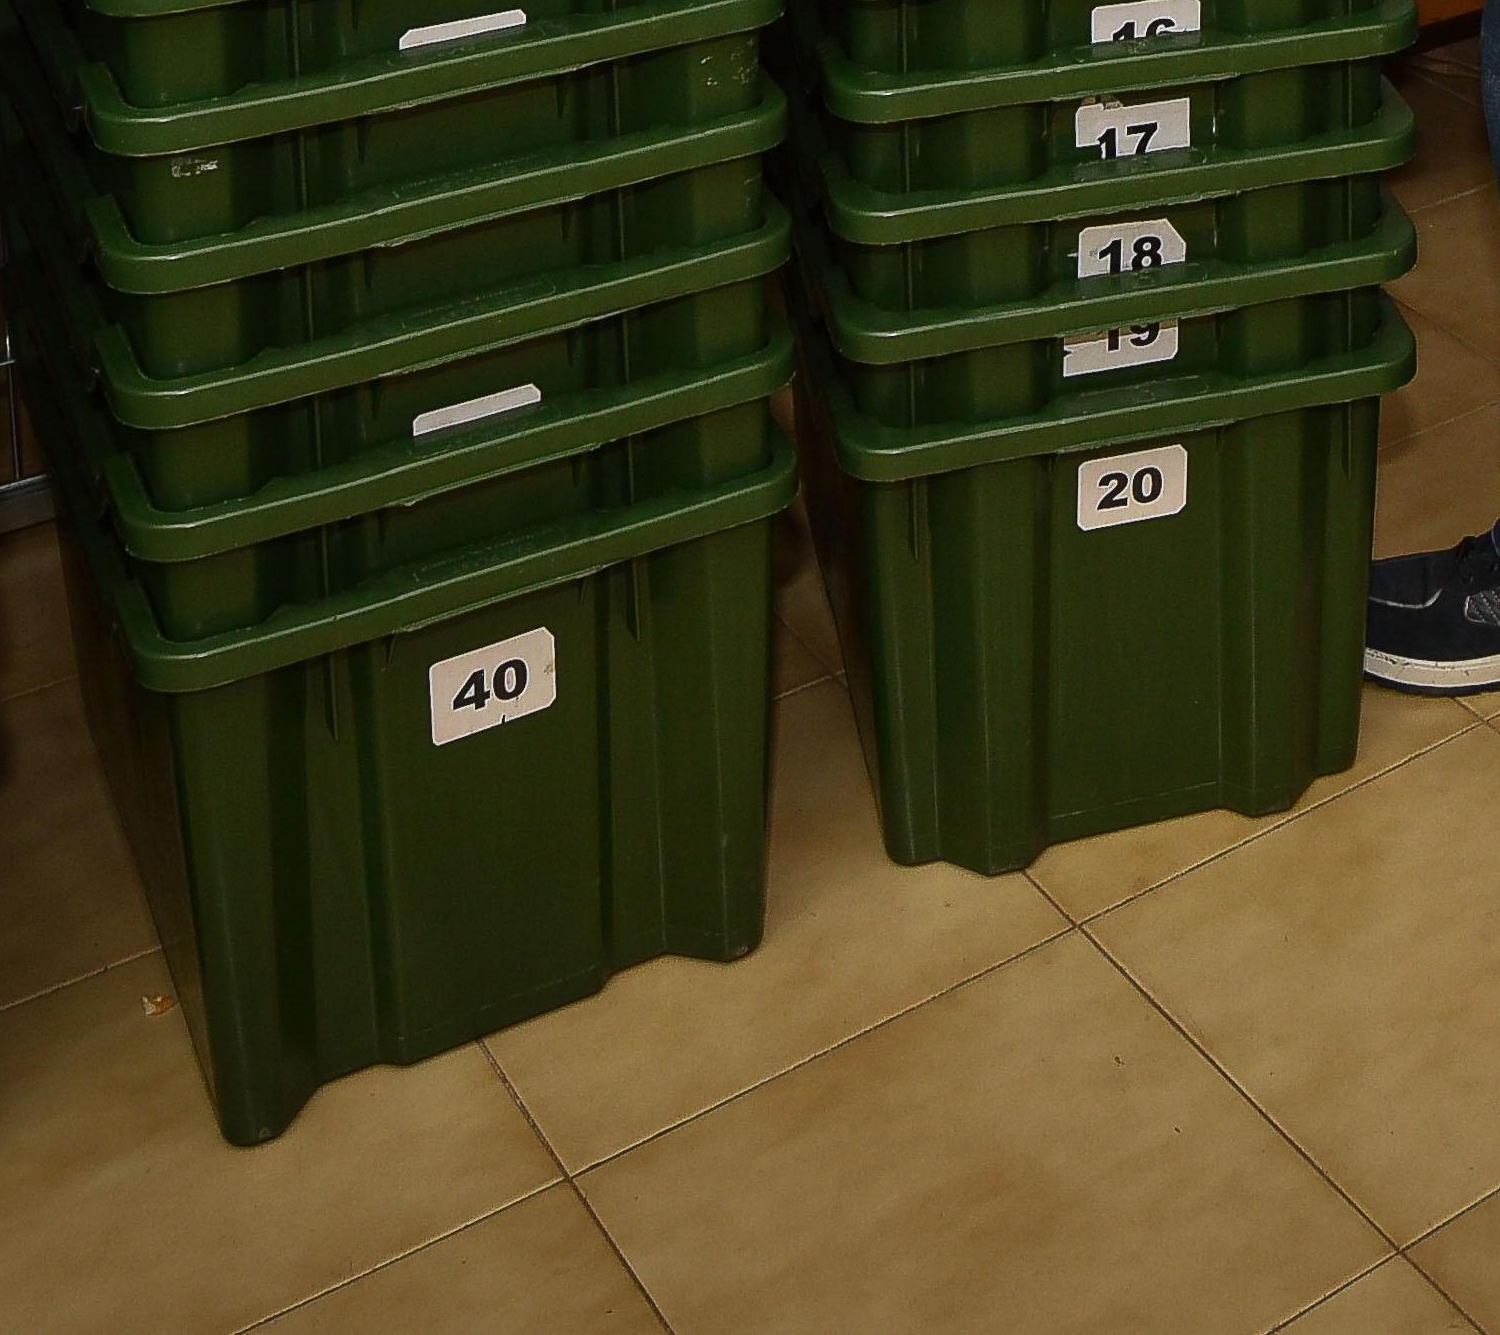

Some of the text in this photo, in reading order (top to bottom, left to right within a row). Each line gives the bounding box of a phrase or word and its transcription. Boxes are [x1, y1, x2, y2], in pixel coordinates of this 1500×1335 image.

[1096, 121, 1159, 160] 17
[1097, 236, 1163, 273] 18
[1096, 466, 1164, 511] 20
[451, 658, 528, 712] 40
